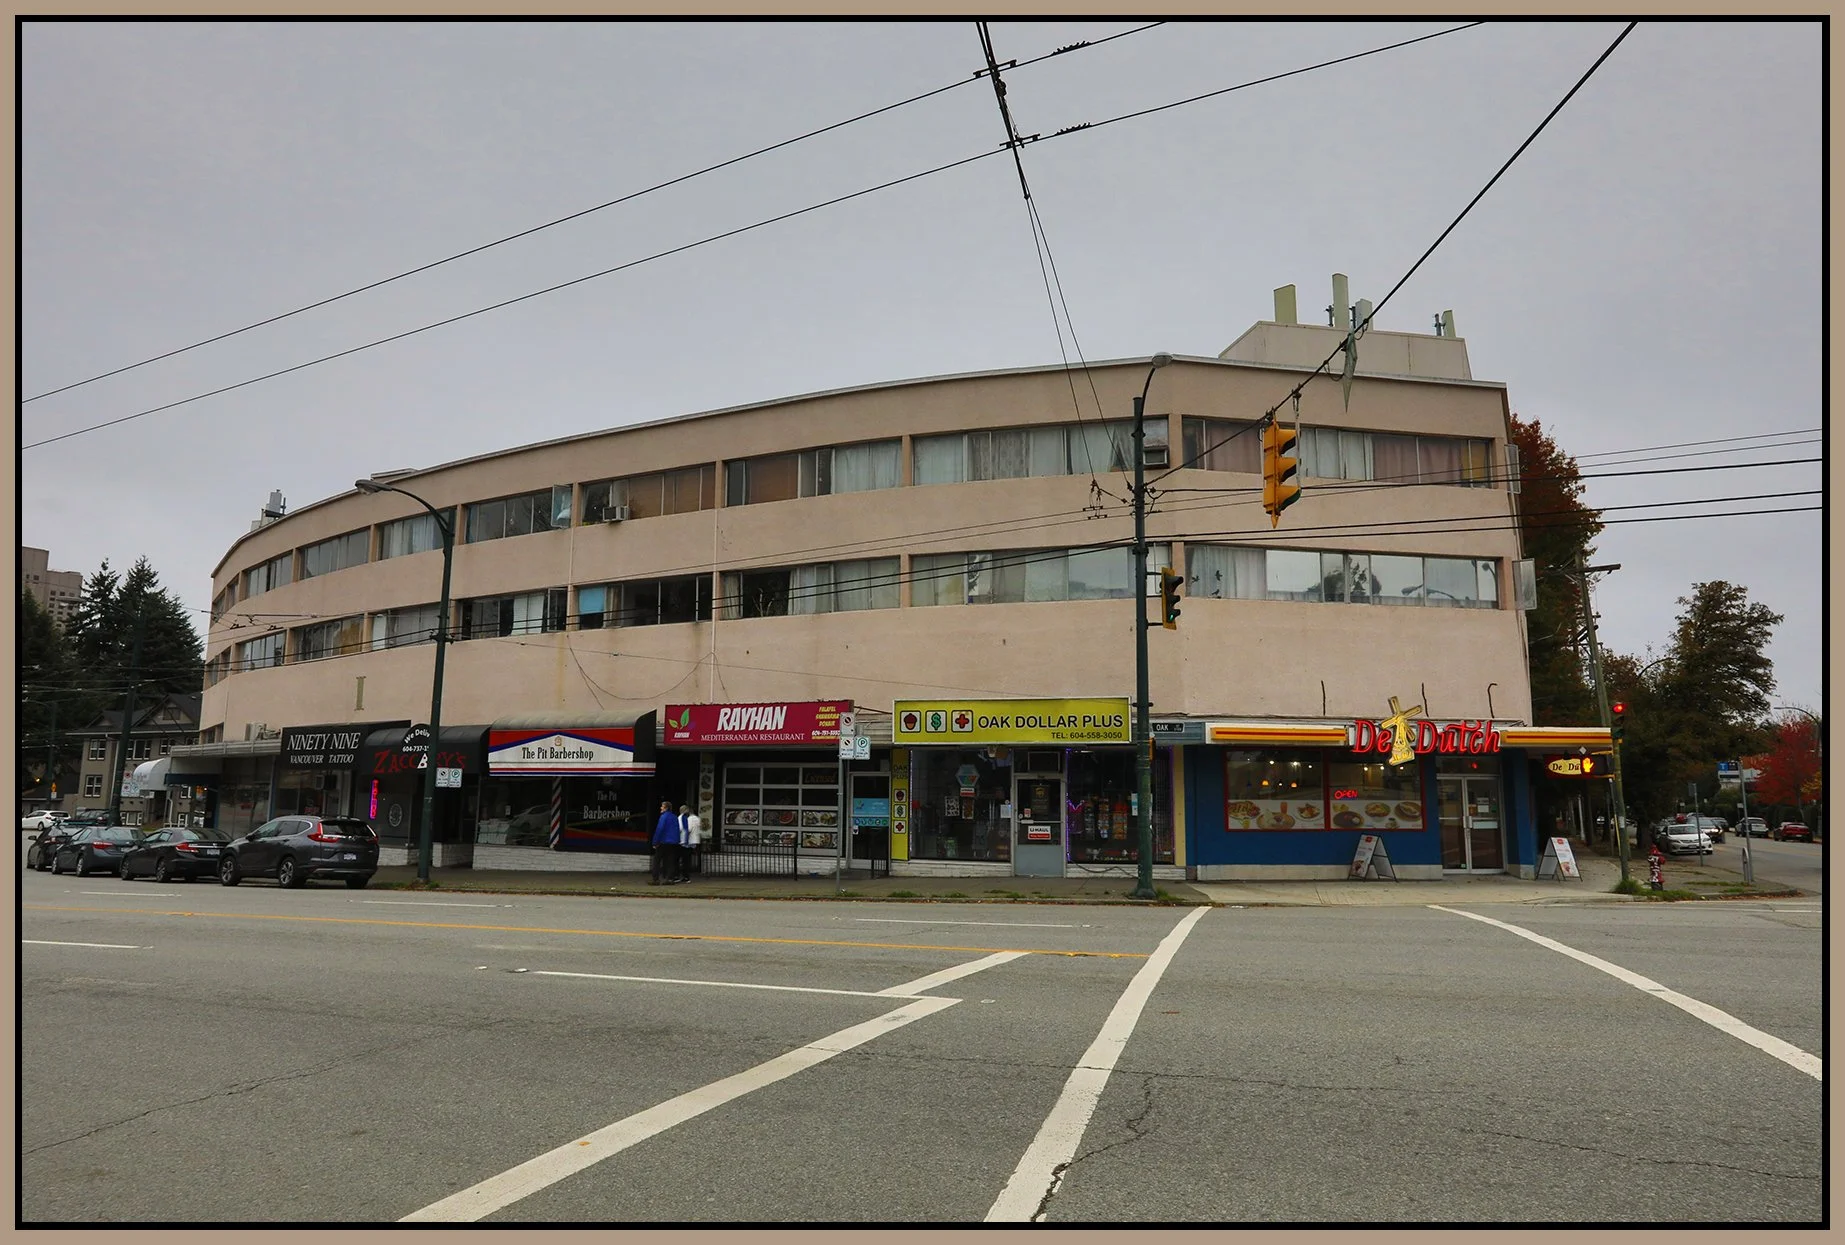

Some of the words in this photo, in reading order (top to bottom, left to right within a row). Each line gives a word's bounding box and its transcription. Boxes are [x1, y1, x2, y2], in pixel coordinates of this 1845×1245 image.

[717, 706, 787, 731] RAYHAN
[978, 715, 1010, 728] OAK
[1015, 715, 1078, 728] DOLLAR
[1083, 714, 1123, 728] PLUS
[1156, 723, 1169, 731] OAK
[287, 733, 331, 750] NINETY
[330, 732, 361, 749] NINE
[403, 733, 414, 745] We
[414, 728, 430, 738] Deliv
[759, 733, 805, 741] RESTAURANT
[1070, 731, 1123, 739] 604-558-3050
[1351, 719, 1391, 754] De
[1414, 719, 1501, 754] Dutch
[290, 755, 324, 764] VANCOUVER
[329, 754, 354, 764] TATTOO
[521, 747, 535, 760] The
[537, 747, 547, 760] Pit
[549, 746, 594, 761] Barbershop
[596, 790, 608, 801] The
[608, 790, 617, 801] Pit
[1333, 789, 1358, 800] OPEN
[583, 804, 631, 822] Barbershop
